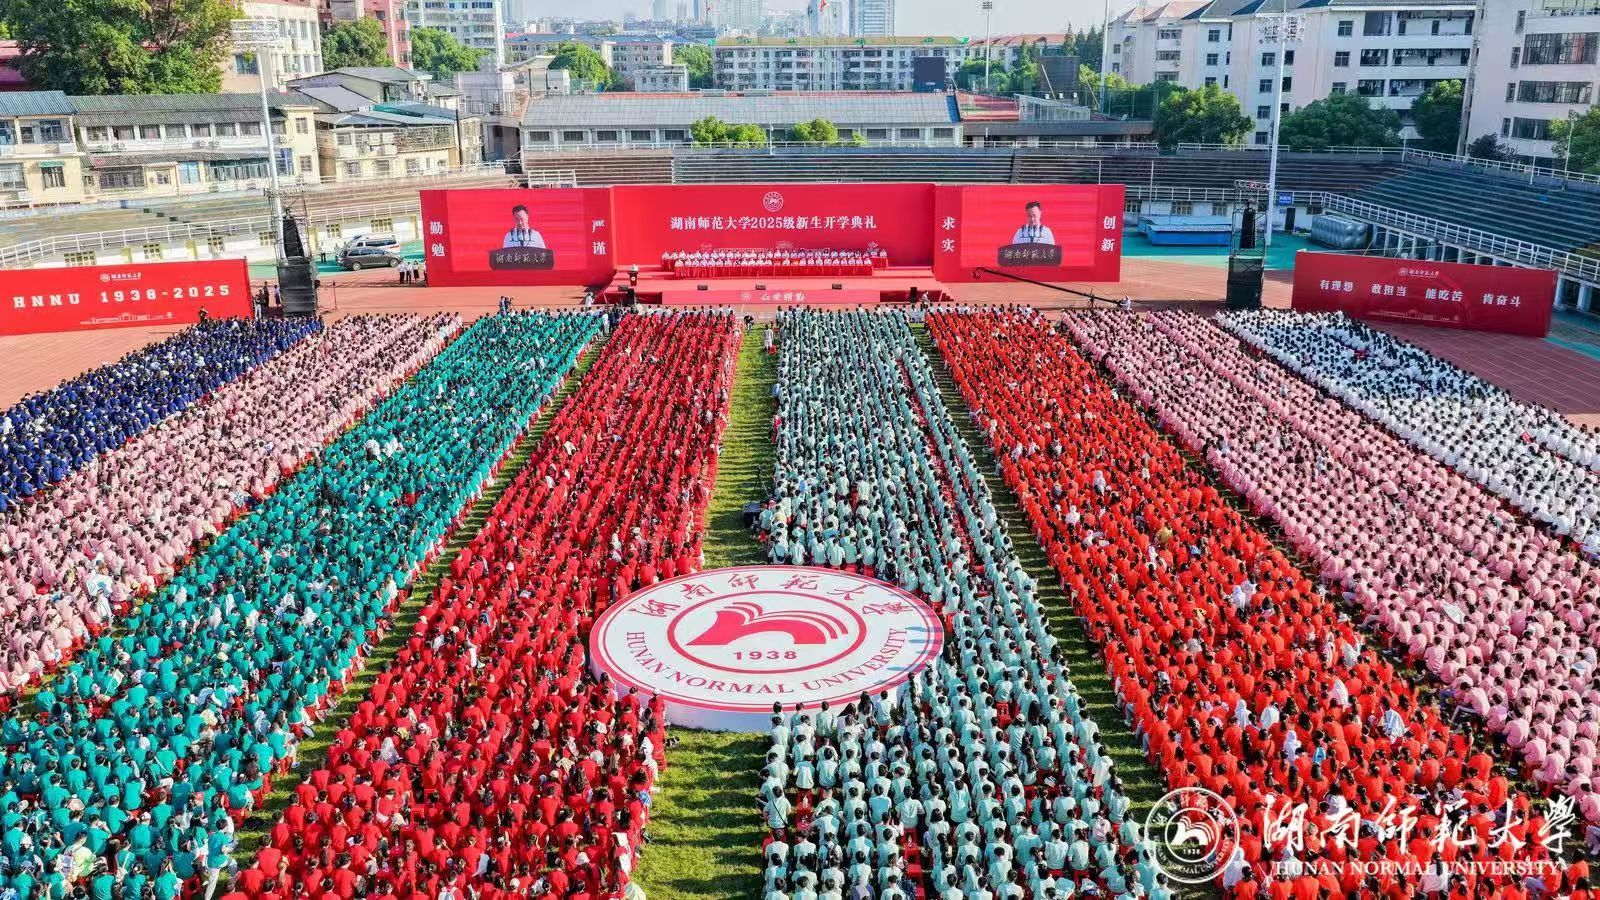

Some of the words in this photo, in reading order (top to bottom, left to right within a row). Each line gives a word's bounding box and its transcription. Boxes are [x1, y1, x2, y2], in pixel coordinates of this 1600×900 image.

[429, 220, 445, 257] 勤勉
[591, 219, 606, 256] 严谨
[670, 215, 877, 230] 湖南师范大学2025级新生开学典礼
[941, 216, 956, 252] 求实
[1101, 215, 1116, 252] 创新
[12, 293, 80, 309] HNNU
[101, 285, 230, 304] 1938-2025
[1319, 279, 1354, 292] 有理想
[1371, 283, 1407, 297] 敢担当
[1425, 288, 1463, 302] 能吃苦
[1482, 293, 1521, 307] 肯奋斗
[626, 631, 671, 673] HUNAN
[665, 671, 795, 694] NORMAL
[800, 627, 908, 692] UNIVERSITY
[733, 650, 797, 661] 1938
